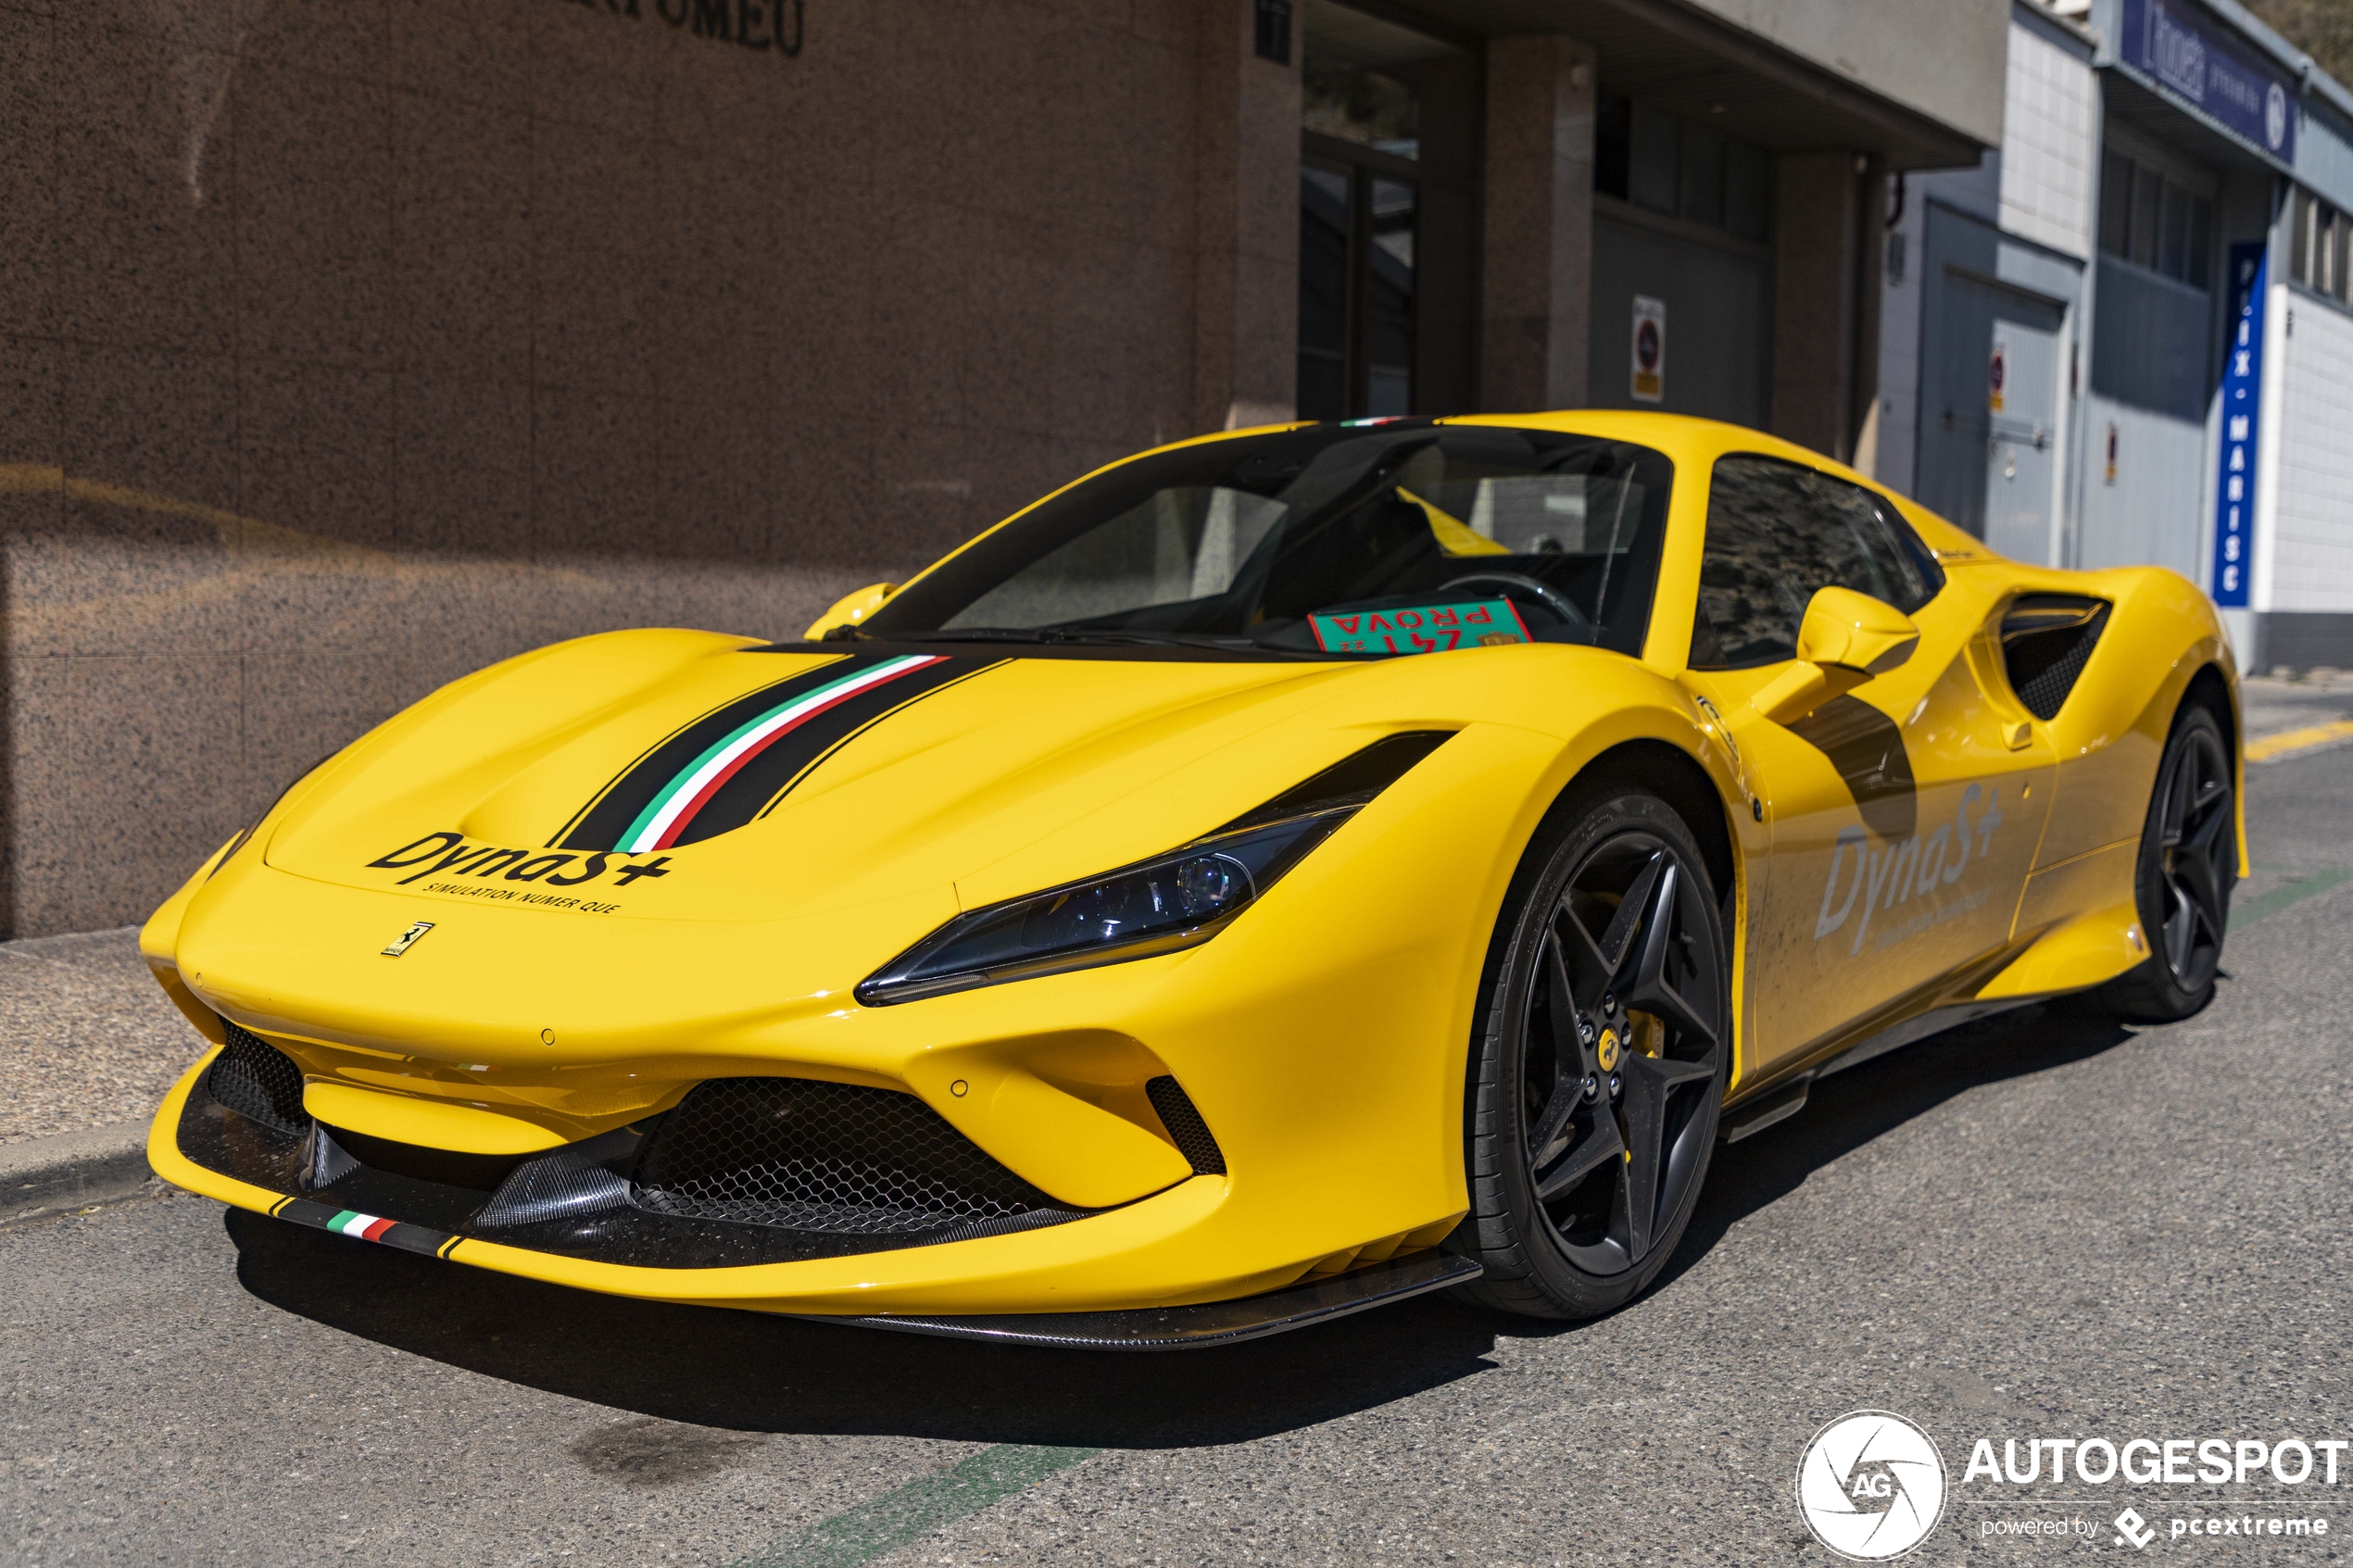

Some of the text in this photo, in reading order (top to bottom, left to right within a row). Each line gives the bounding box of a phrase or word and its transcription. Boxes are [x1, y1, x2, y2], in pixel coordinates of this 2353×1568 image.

[2222, 414, 2249, 592] MARISC
[1331, 605, 1493, 635] PROVA
[365, 832, 673, 886] DynaS+
[1813, 784, 2004, 957] DynaS+
[422, 883, 622, 914] SIMULATION NUMER QUE
